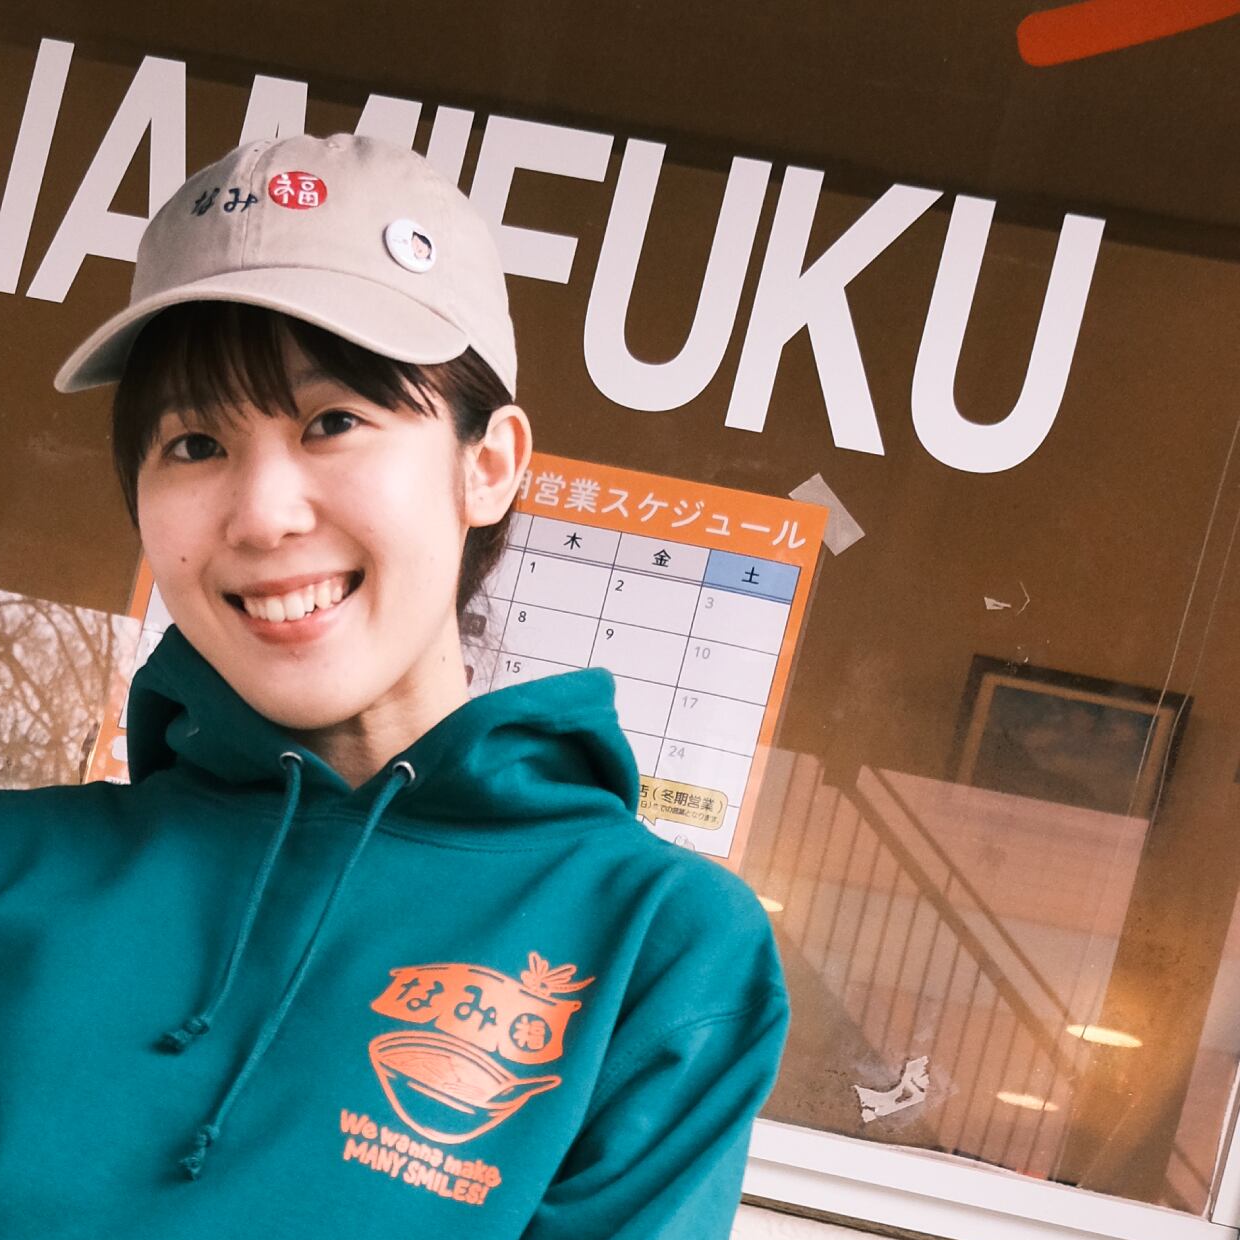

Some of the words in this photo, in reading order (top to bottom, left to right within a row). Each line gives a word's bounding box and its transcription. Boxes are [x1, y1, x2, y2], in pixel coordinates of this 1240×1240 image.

[563, 532, 583, 550] 木
[651, 549, 672, 568] 金
[741, 567, 760, 585] 土
[529, 562, 536, 573] 1
[614, 580, 624, 592] 2
[704, 597, 714, 609] 3
[518, 611, 527, 623] 8
[605, 628, 615, 640] 9
[695, 646, 711, 659] 10
[505, 660, 521, 673] 15
[682, 696, 698, 709] 17
[668, 745, 685, 759] 24
[340, 1109, 378, 1139] We
[380, 1126, 443, 1167] wanna
[443, 1155, 502, 1187] make
[343, 1138, 408, 1178] MANY
[403, 1160, 490, 1205] SMILES!
